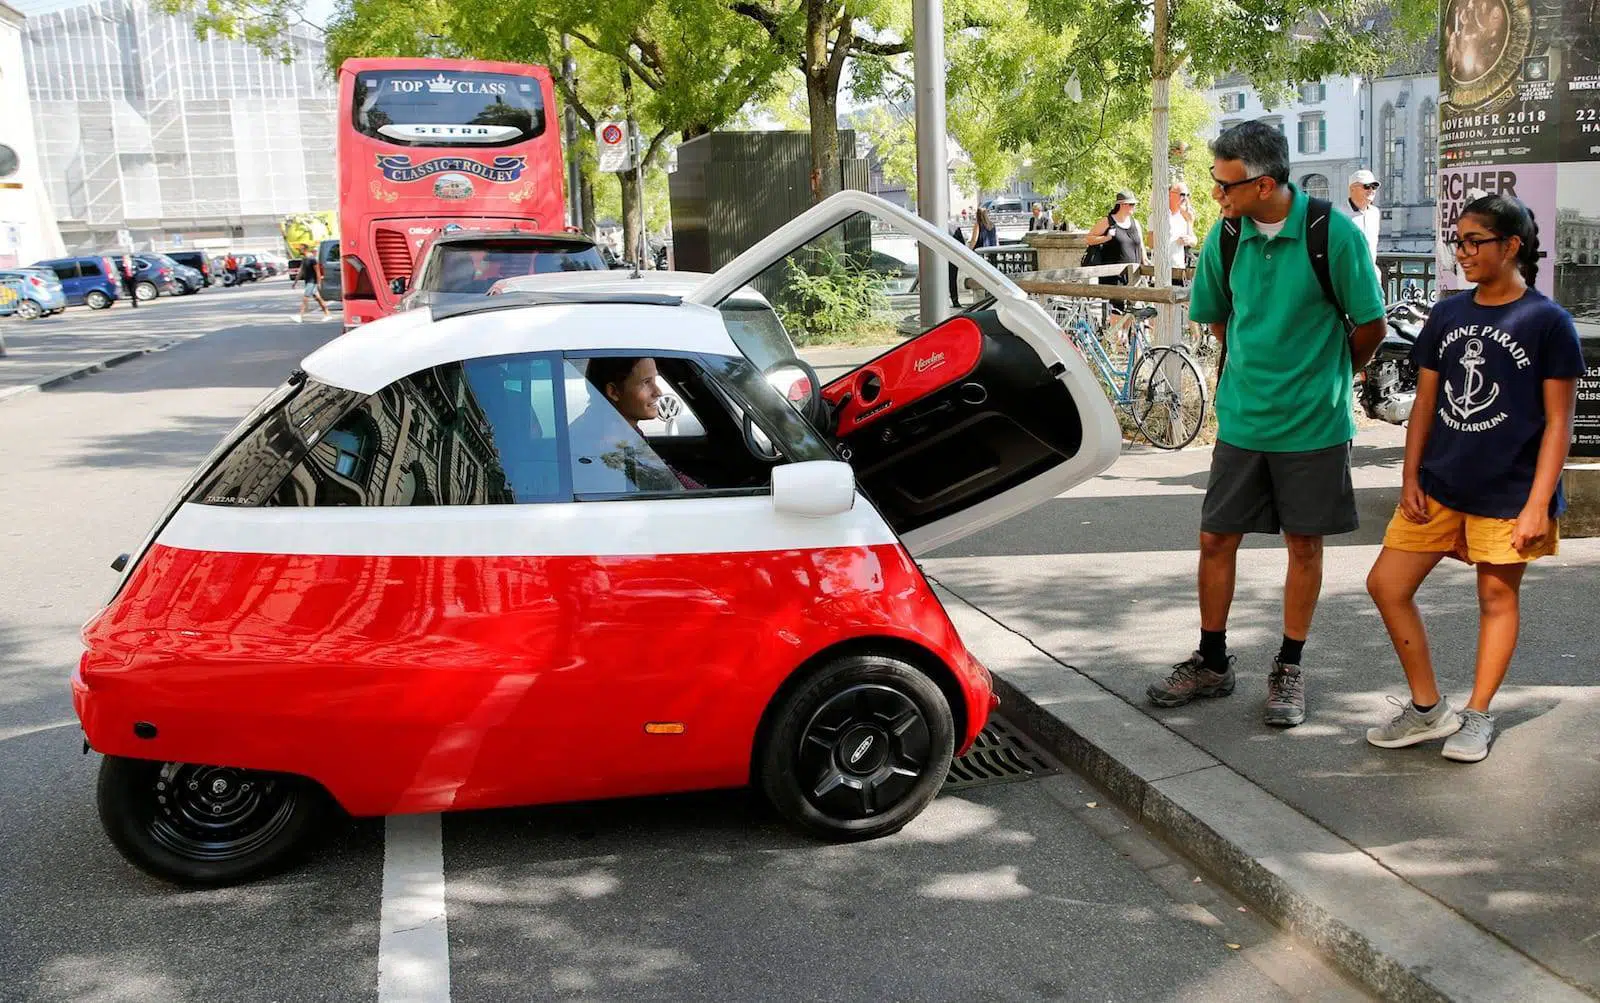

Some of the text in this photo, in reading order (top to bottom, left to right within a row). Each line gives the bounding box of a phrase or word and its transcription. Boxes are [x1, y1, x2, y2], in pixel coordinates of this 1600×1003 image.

[391, 80, 506, 95] TOP CLASS
[1507, 110, 1547, 124] 2018
[1492, 125, 1540, 137] ZÜRICH
[391, 160, 513, 181] CLASSIC TROLLEY
[1481, 325, 1531, 370] PARADE
[1461, 411, 1509, 432] CAROLINA
